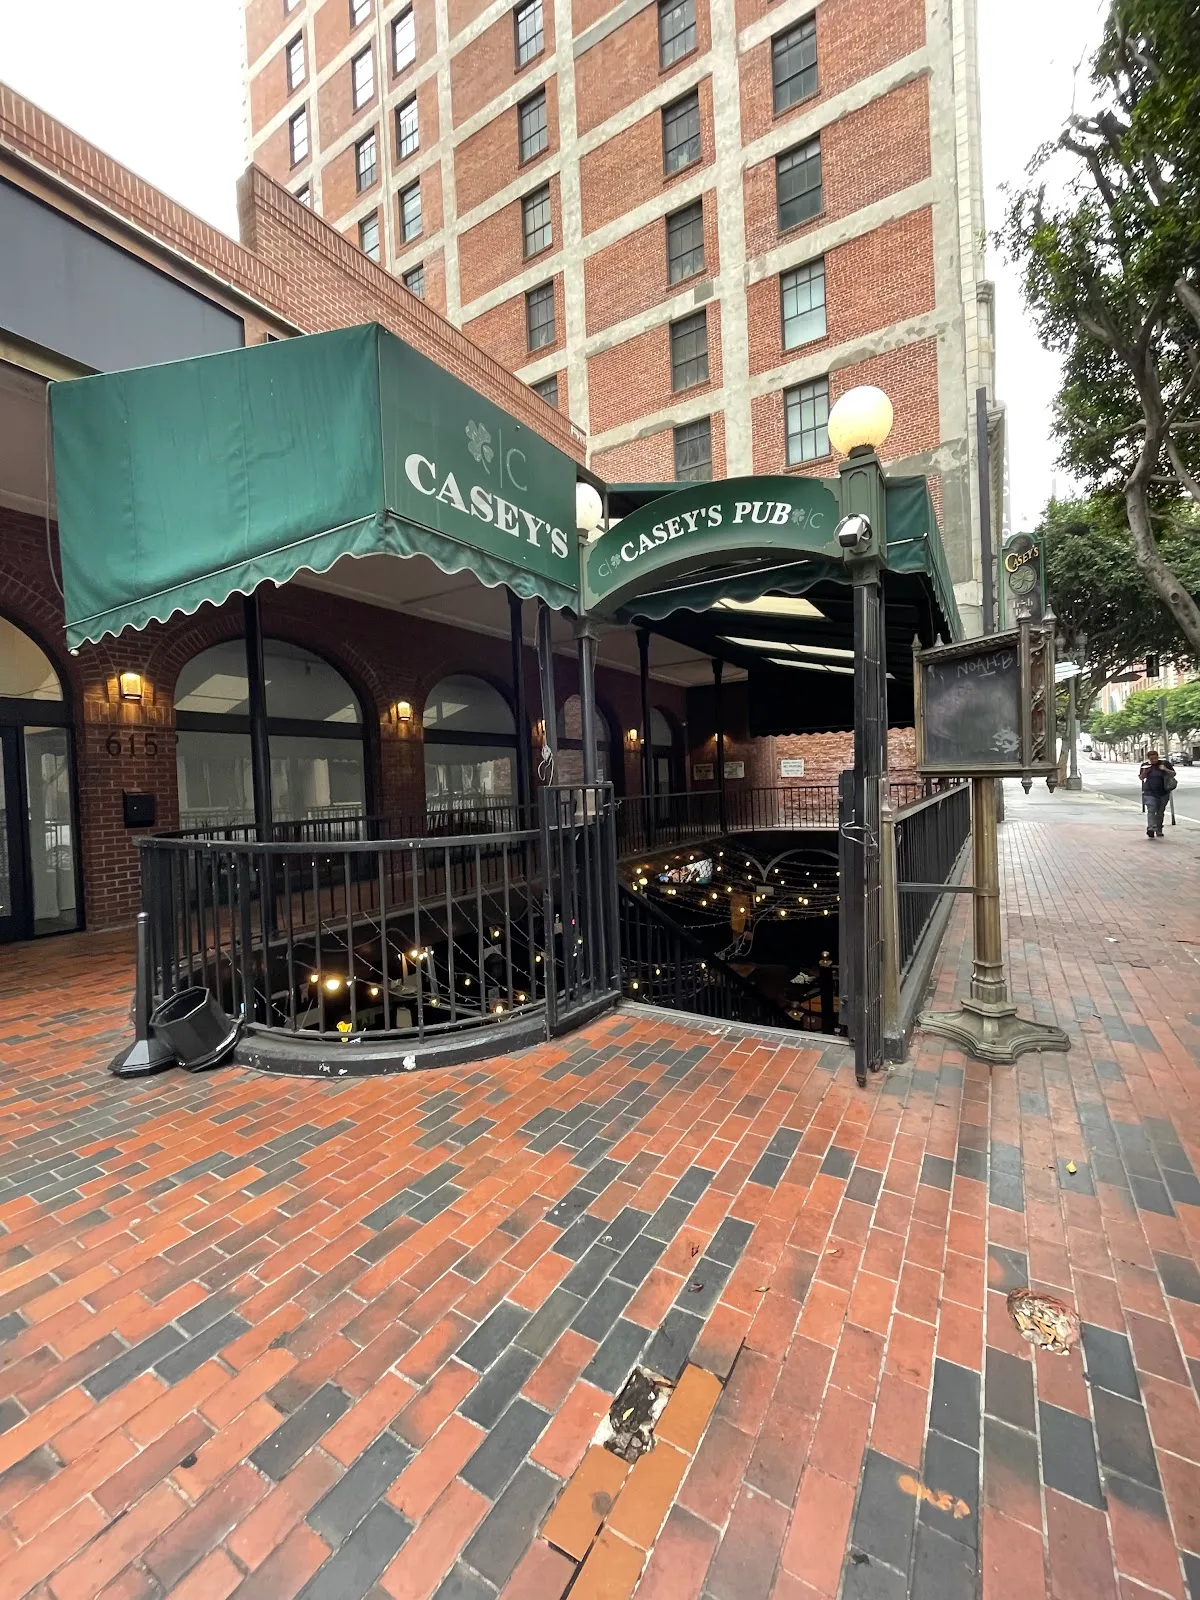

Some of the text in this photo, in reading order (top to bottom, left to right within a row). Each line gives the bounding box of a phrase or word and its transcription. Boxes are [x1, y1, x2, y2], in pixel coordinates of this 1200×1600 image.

[405, 453, 569, 559] CASEY'S
[620, 504, 723, 563] CASEY'S
[732, 501, 792, 525] PUB
[105, 731, 158, 758] 615
